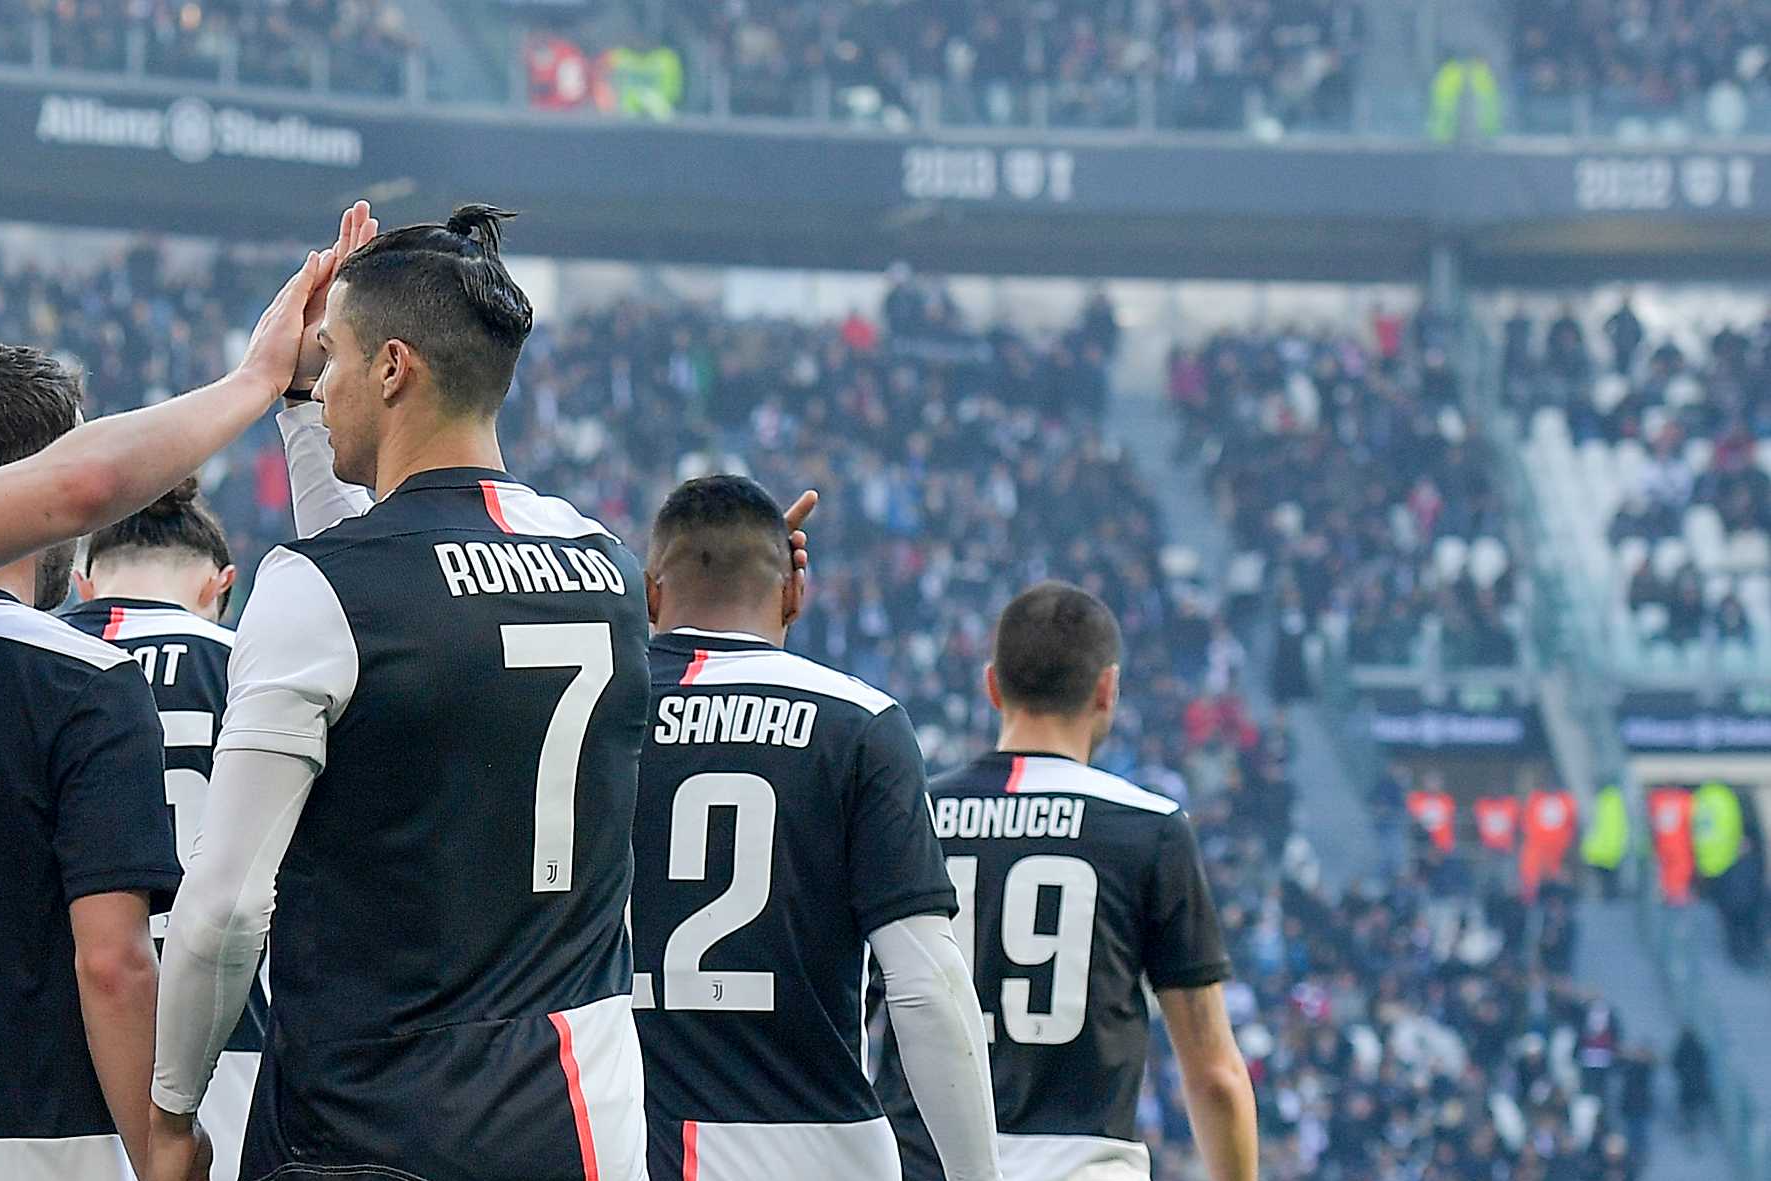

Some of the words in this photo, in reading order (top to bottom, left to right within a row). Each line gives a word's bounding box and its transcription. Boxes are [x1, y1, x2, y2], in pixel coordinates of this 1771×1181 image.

[434, 542, 626, 598] RONALDO
[654, 696, 818, 748] SANDRO
[499, 622, 614, 893] 7
[936, 797, 1085, 839] BONUCCI
[632, 772, 776, 1011] 2
